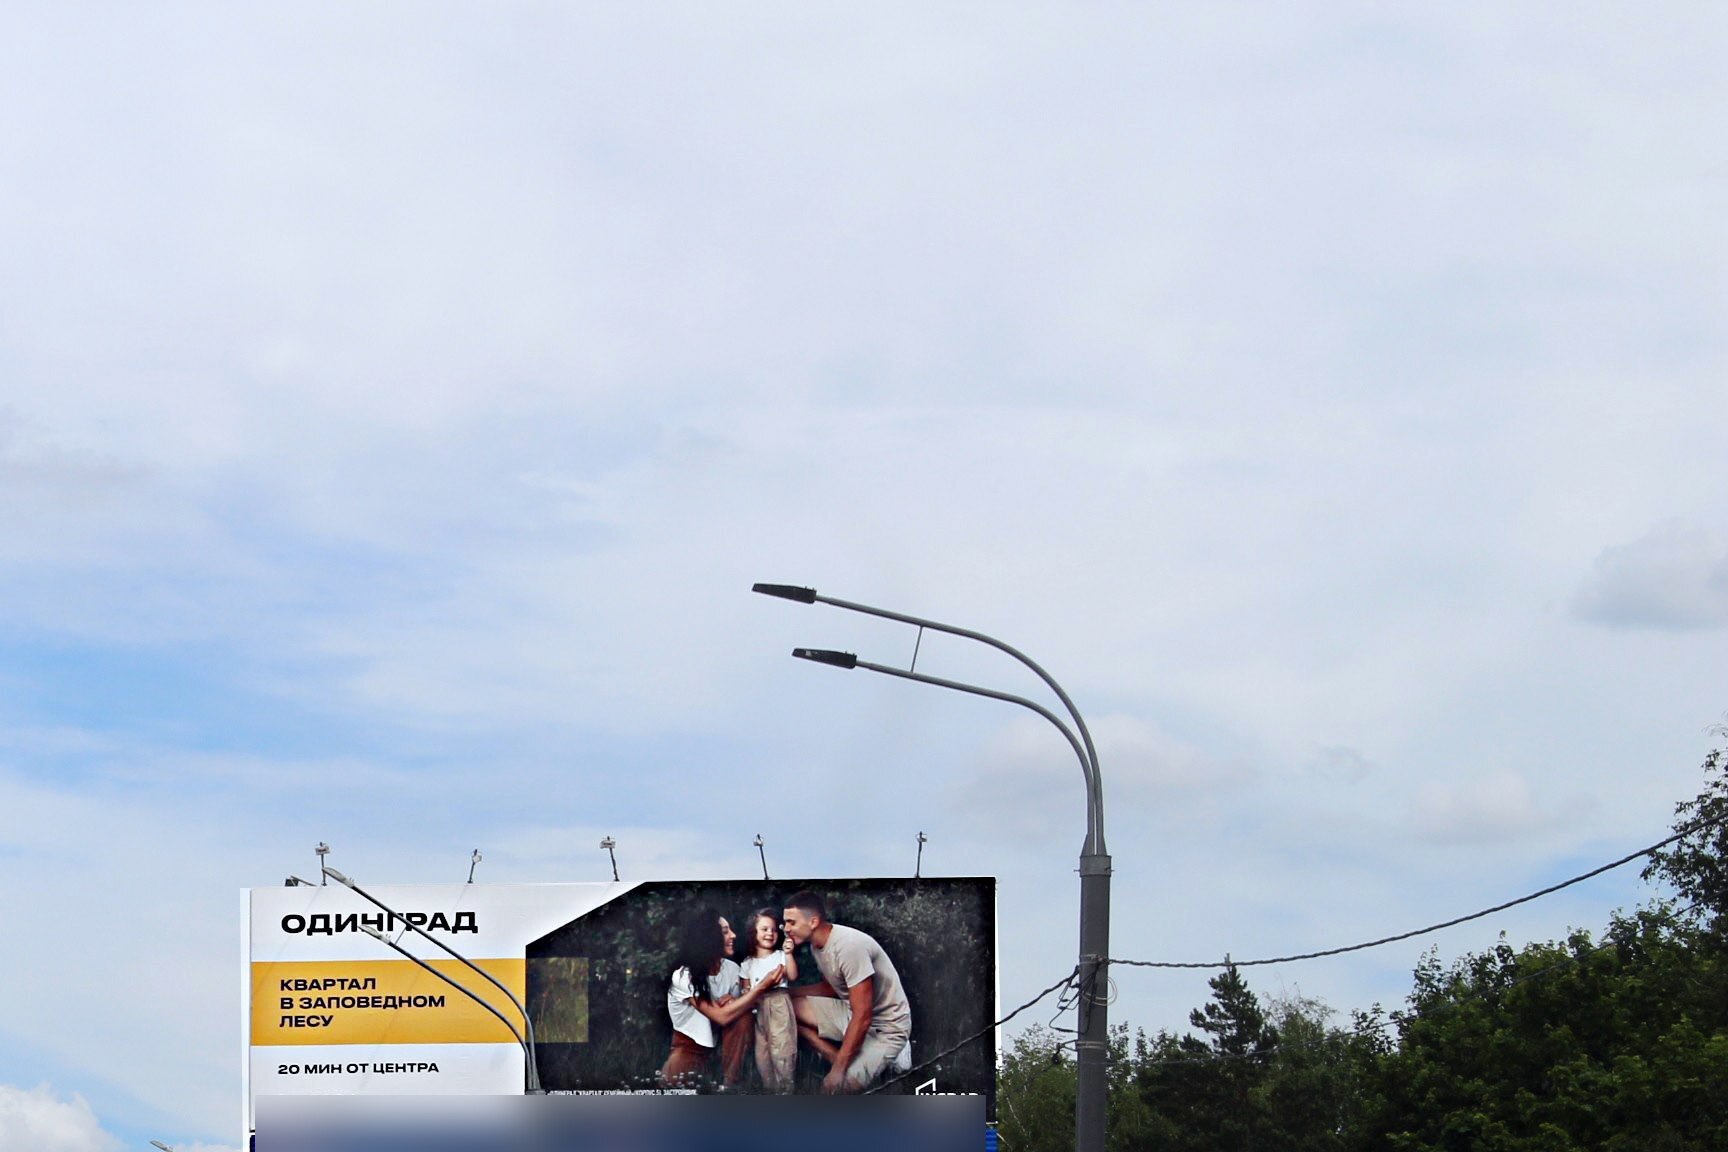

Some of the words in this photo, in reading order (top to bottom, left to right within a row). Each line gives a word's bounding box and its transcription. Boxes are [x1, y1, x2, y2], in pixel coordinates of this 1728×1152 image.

[281, 912, 478, 936] ОДИНГРАД
[280, 978, 376, 991] КВАРТАЛ
[280, 998, 294, 1009] В
[299, 996, 445, 1009] ЗАПОВЕДНОМ
[279, 1016, 334, 1028] ЛЕСУ
[278, 1065, 300, 1075] 20
[304, 1064, 342, 1074] МИН
[346, 1064, 369, 1074] ОТ
[373, 1063, 440, 1074] ЦЕНТРА
